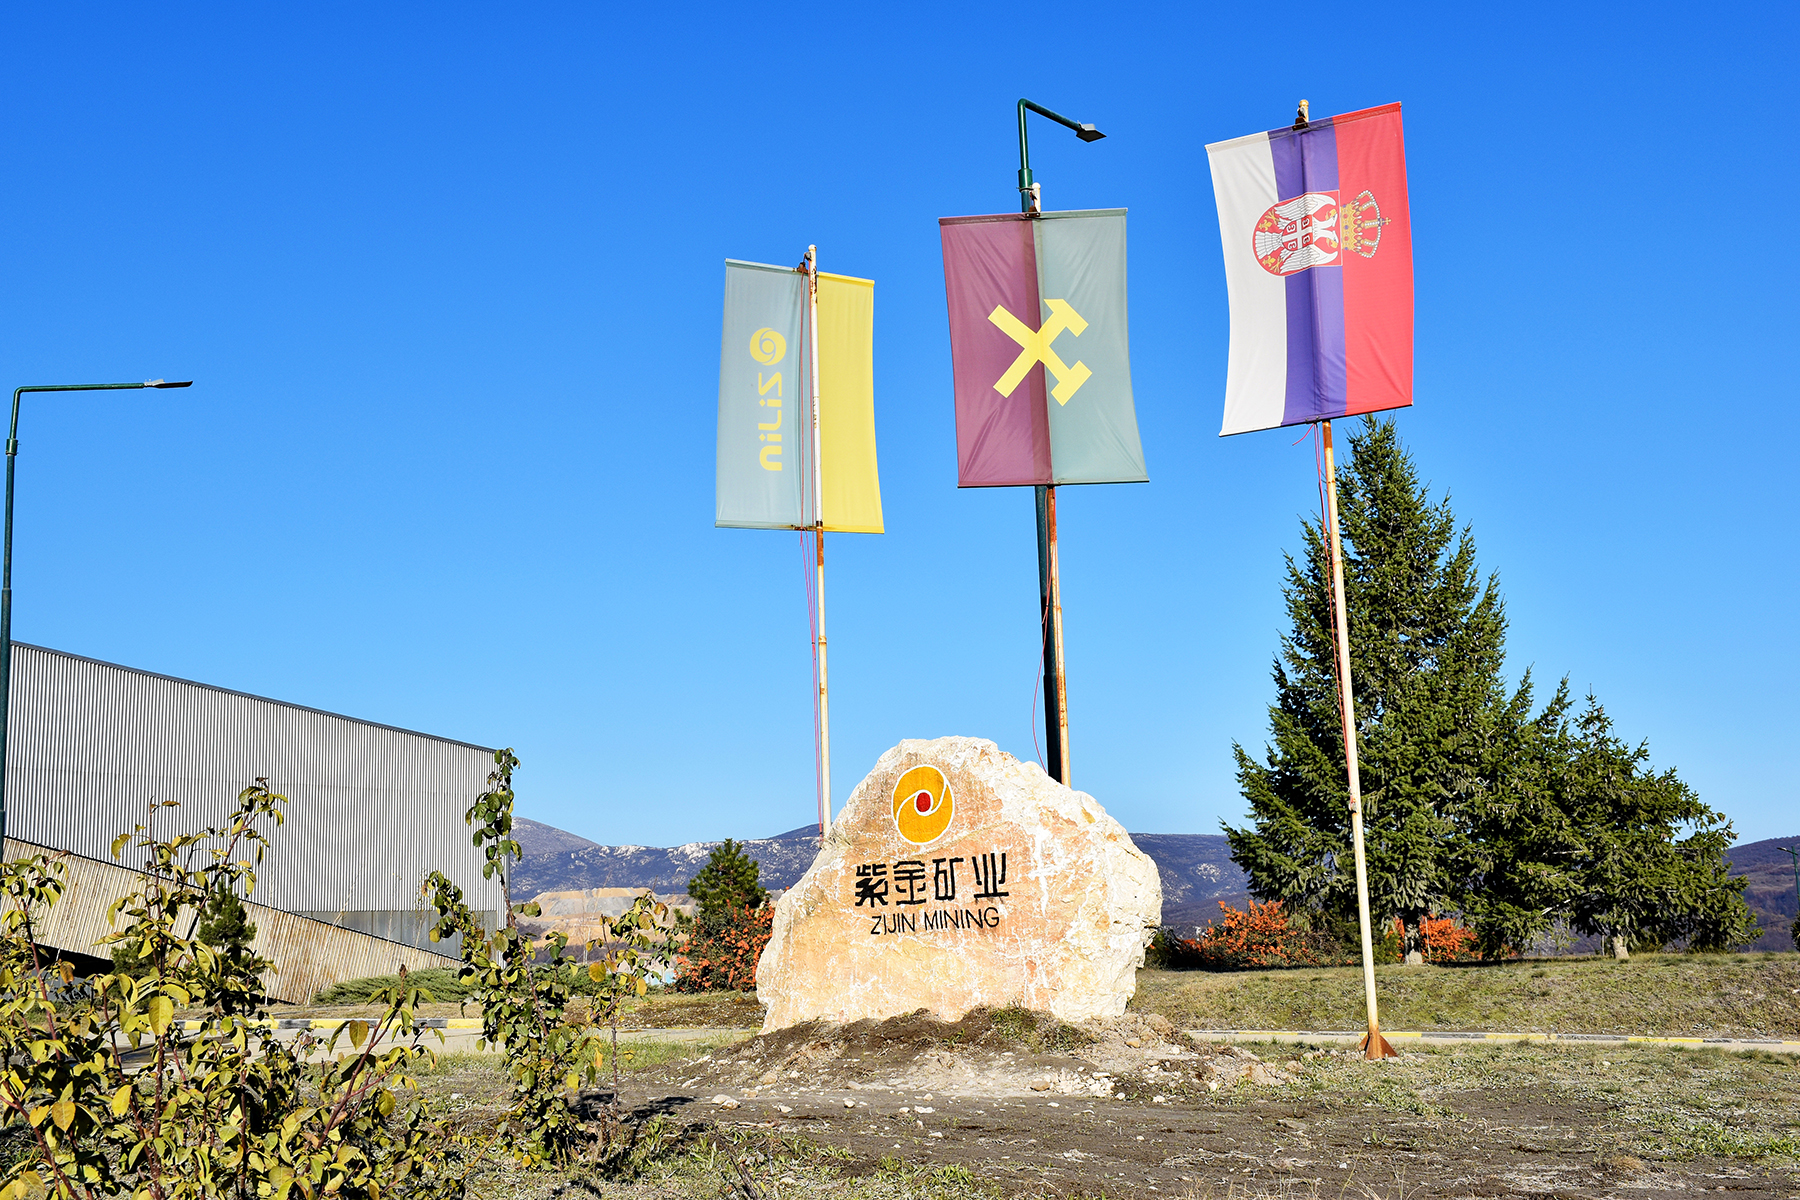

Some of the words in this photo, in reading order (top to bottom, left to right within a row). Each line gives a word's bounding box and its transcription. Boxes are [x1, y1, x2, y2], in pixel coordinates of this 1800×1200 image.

[854, 852, 1010, 907] 紫金矿业
[870, 912, 916, 936] ZIJIN
[924, 906, 1001, 931] MINING
